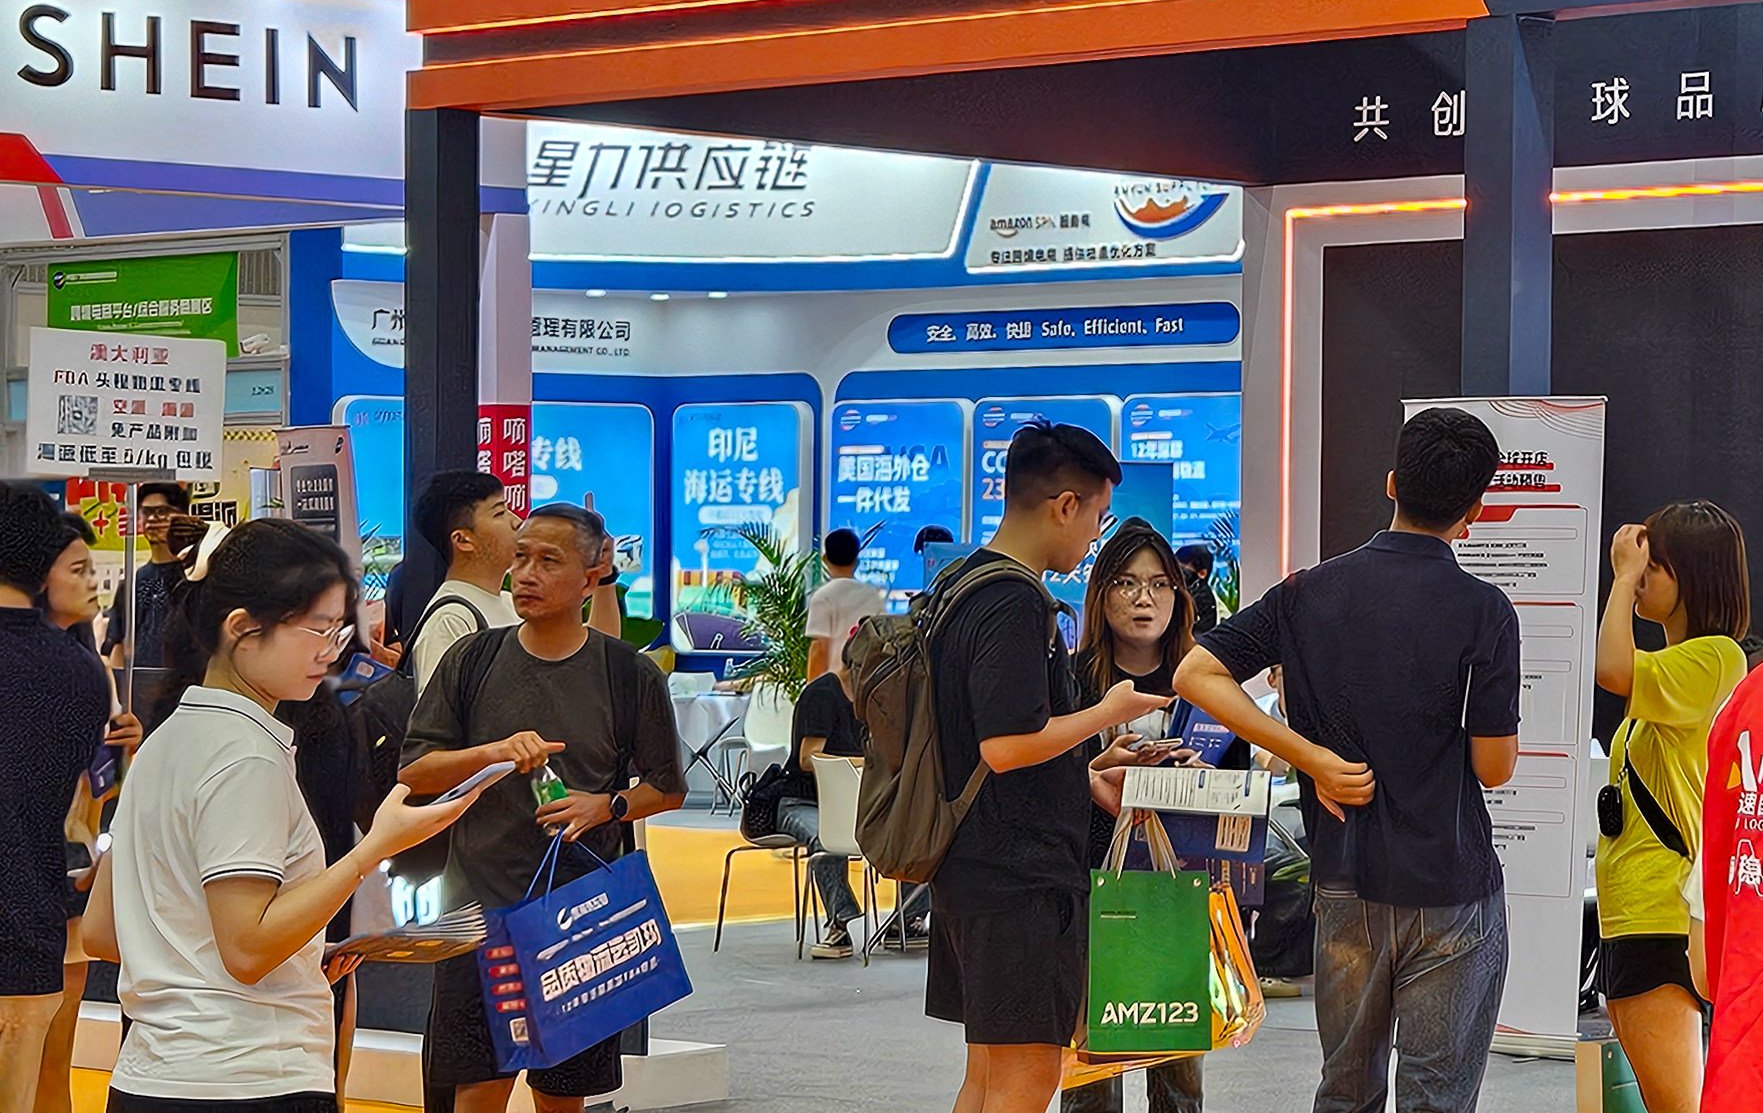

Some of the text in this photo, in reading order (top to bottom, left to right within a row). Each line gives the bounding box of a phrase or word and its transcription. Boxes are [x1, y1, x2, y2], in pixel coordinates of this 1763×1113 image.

[17, 3, 360, 114] SHEIN
[527, 140, 814, 200] 星力供应链
[708, 426, 759, 463] 印尼
[837, 453, 931, 483] 美国海外仓
[1101, 1001, 1199, 1025] AMZ123
